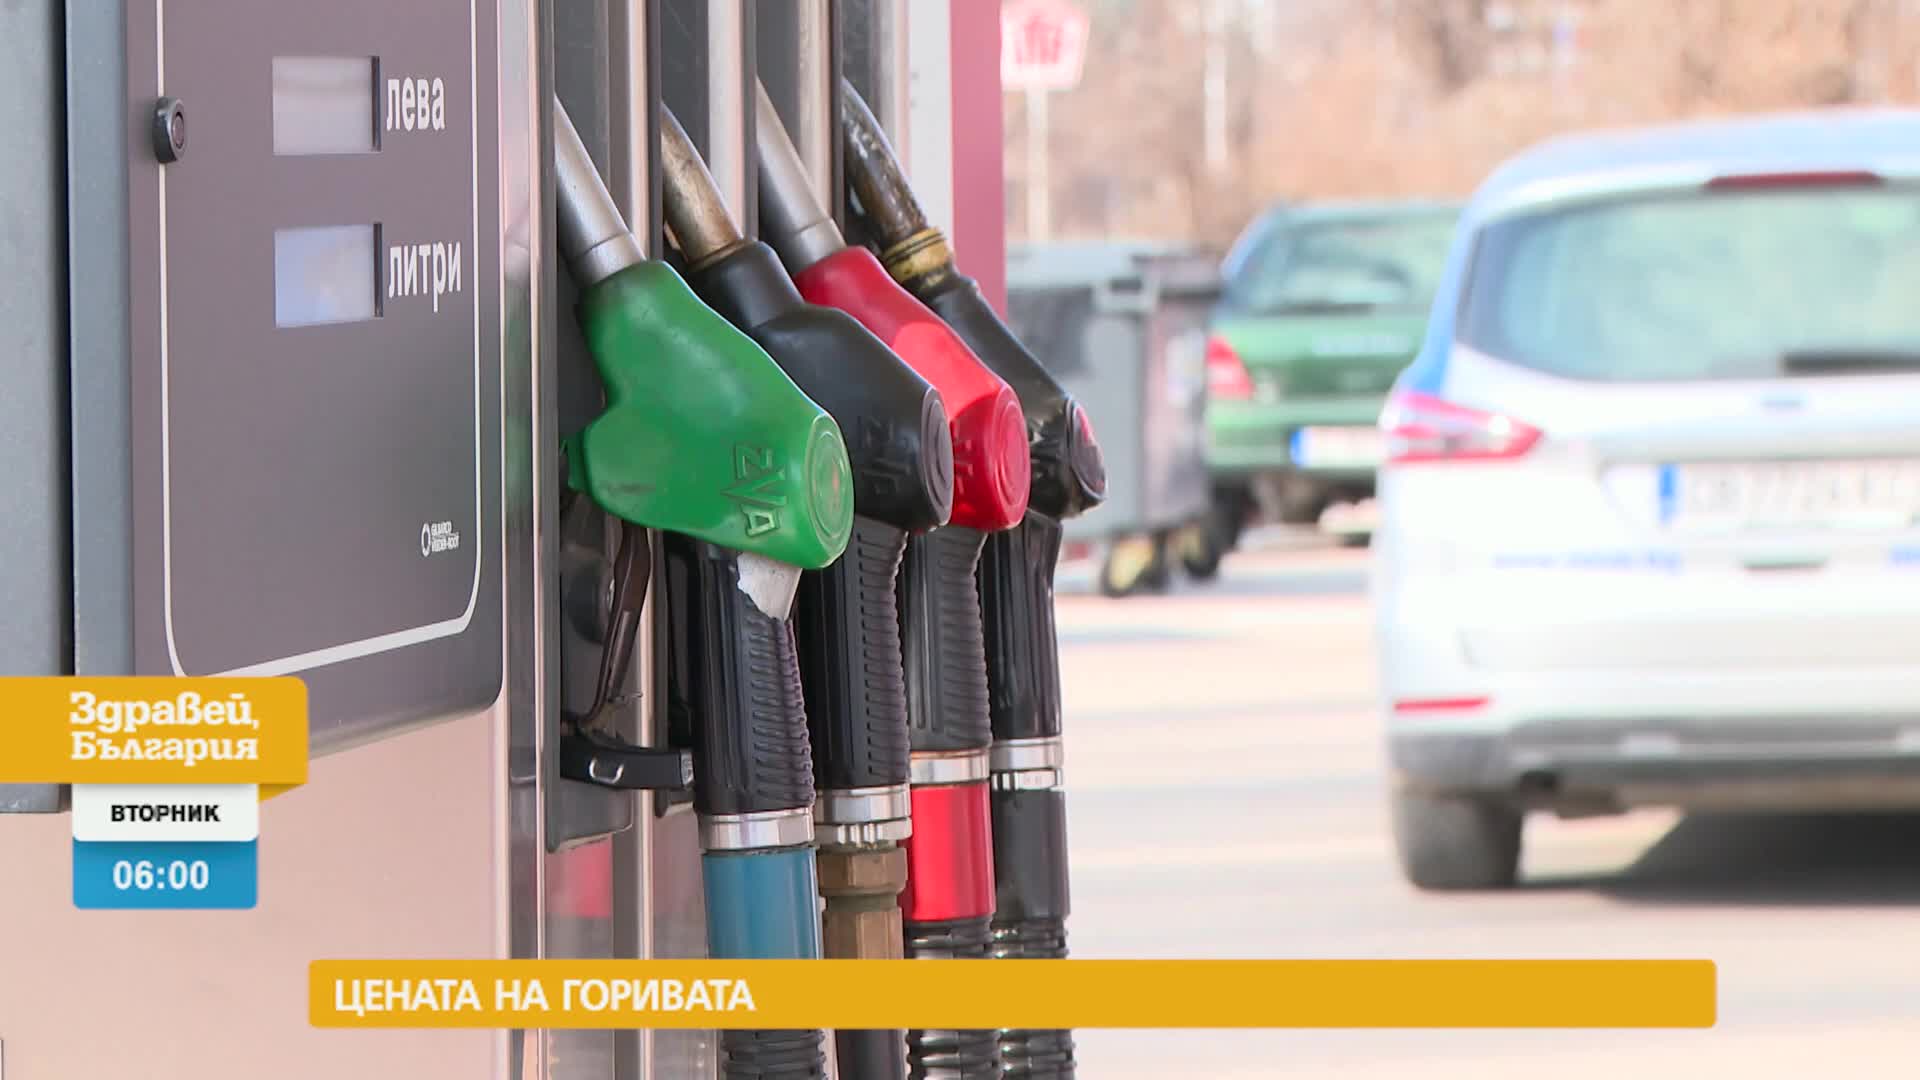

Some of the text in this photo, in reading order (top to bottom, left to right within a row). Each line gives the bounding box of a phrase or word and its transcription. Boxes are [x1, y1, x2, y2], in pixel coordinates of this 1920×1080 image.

[386, 76, 446, 132] лева
[388, 241, 462, 313] литри
[720, 445, 788, 538] ZVA
